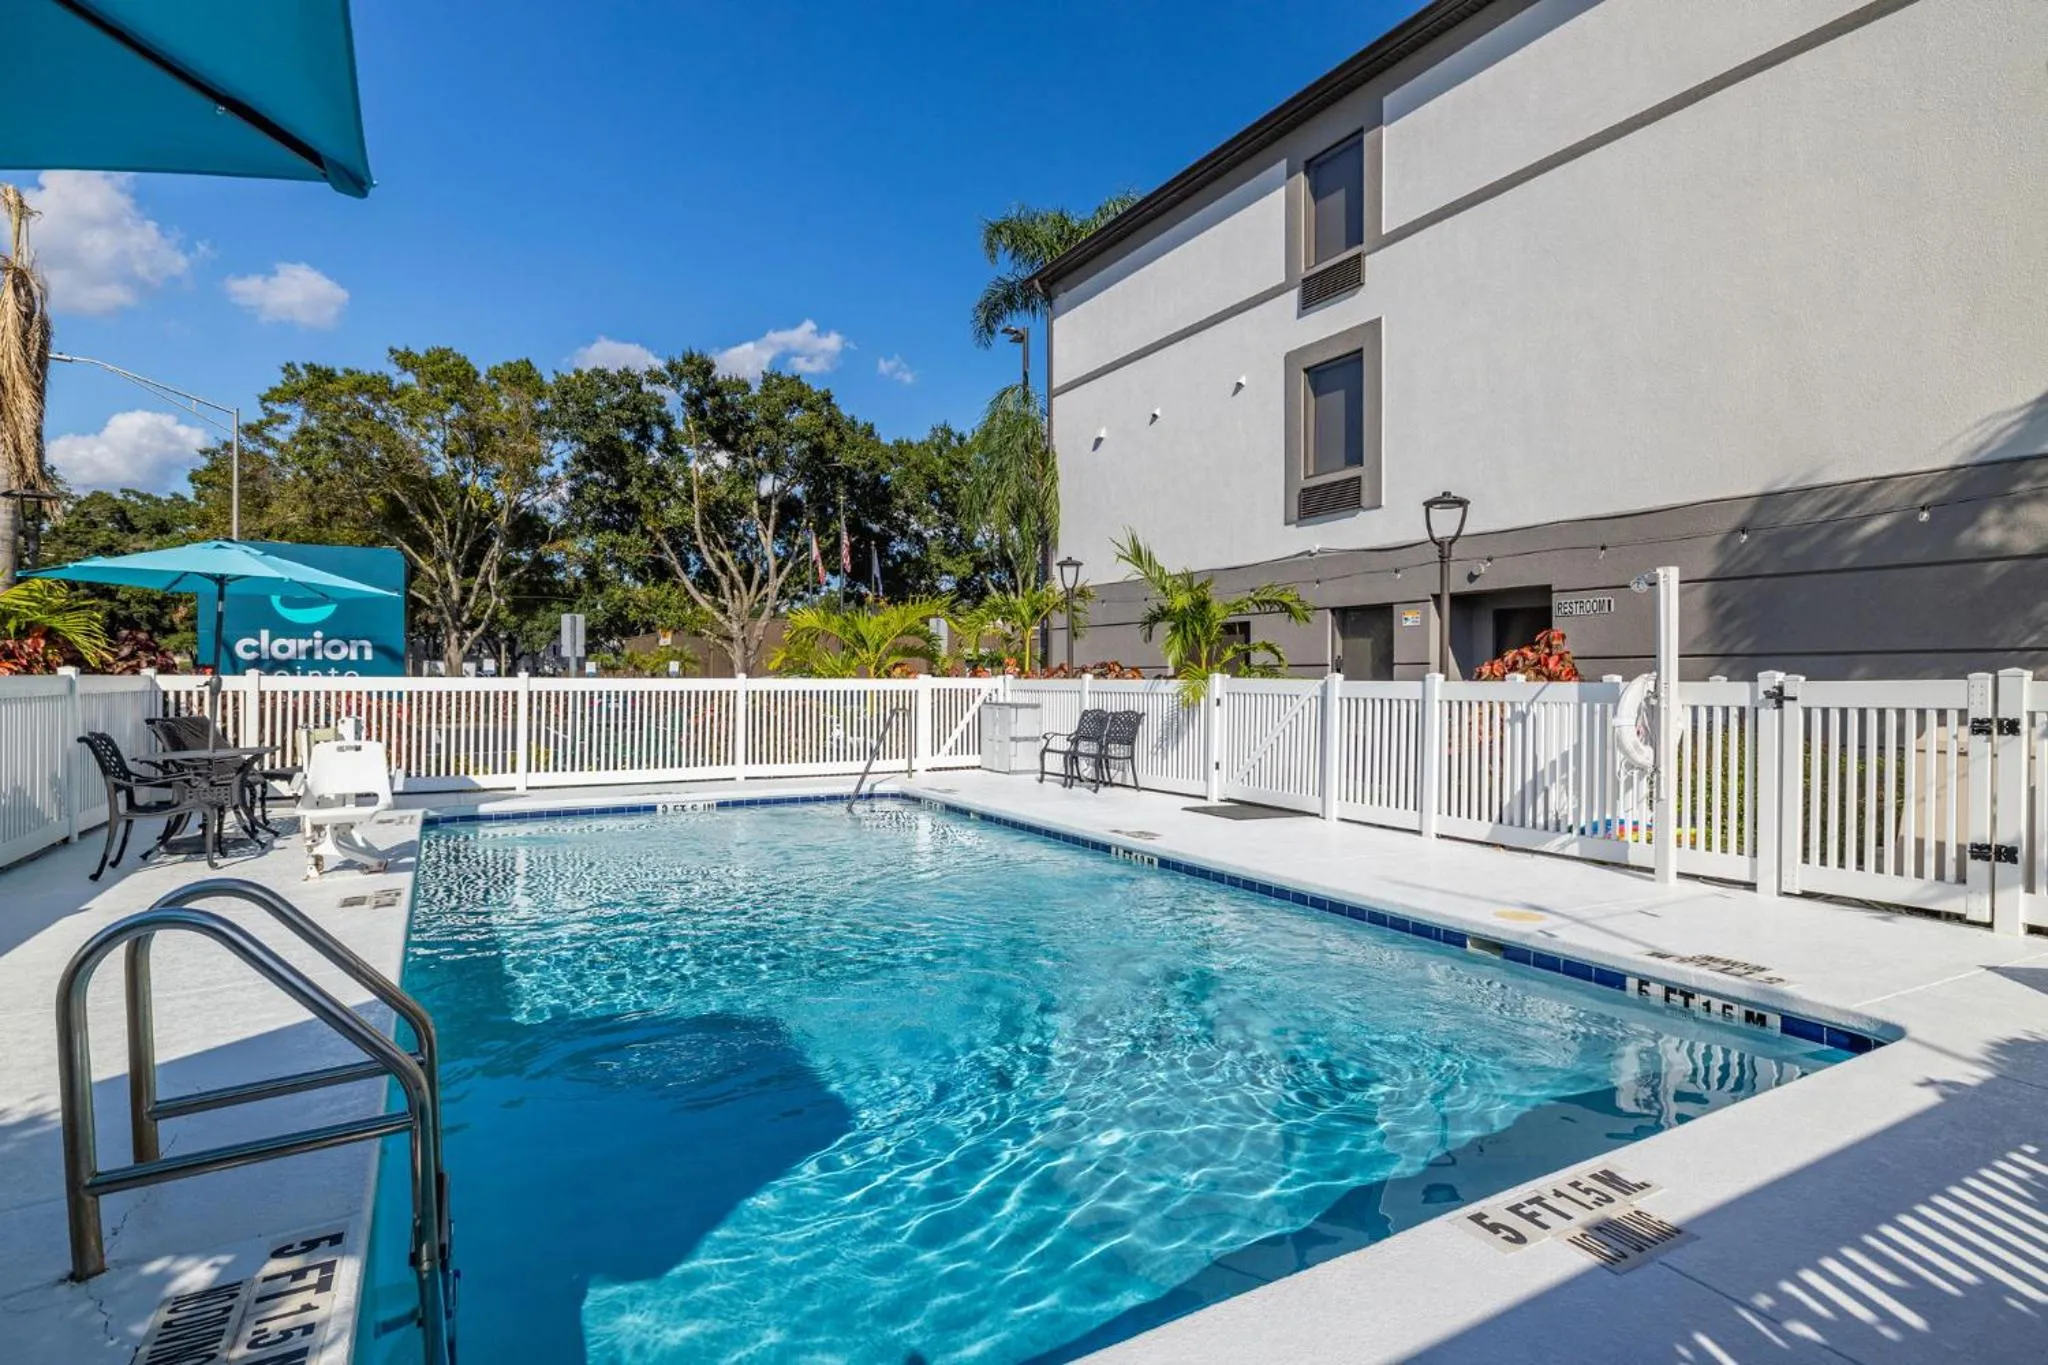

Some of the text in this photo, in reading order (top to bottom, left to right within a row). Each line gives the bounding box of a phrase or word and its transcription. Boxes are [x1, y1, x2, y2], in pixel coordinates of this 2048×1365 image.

[234, 628, 373, 661] clarion
[1664, 985, 1696, 1008] FT
[1467, 1212, 1528, 1245] 5
[1505, 1195, 1574, 1231] FT
[1552, 1180, 1616, 1212] 1.5
[270, 1231, 345, 1259] 5
[1566, 1209, 1683, 1266] NO DIVING
[167, 1281, 243, 1315] NO
[254, 1259, 338, 1304] FT
[246, 1303, 319, 1350] 1.5
